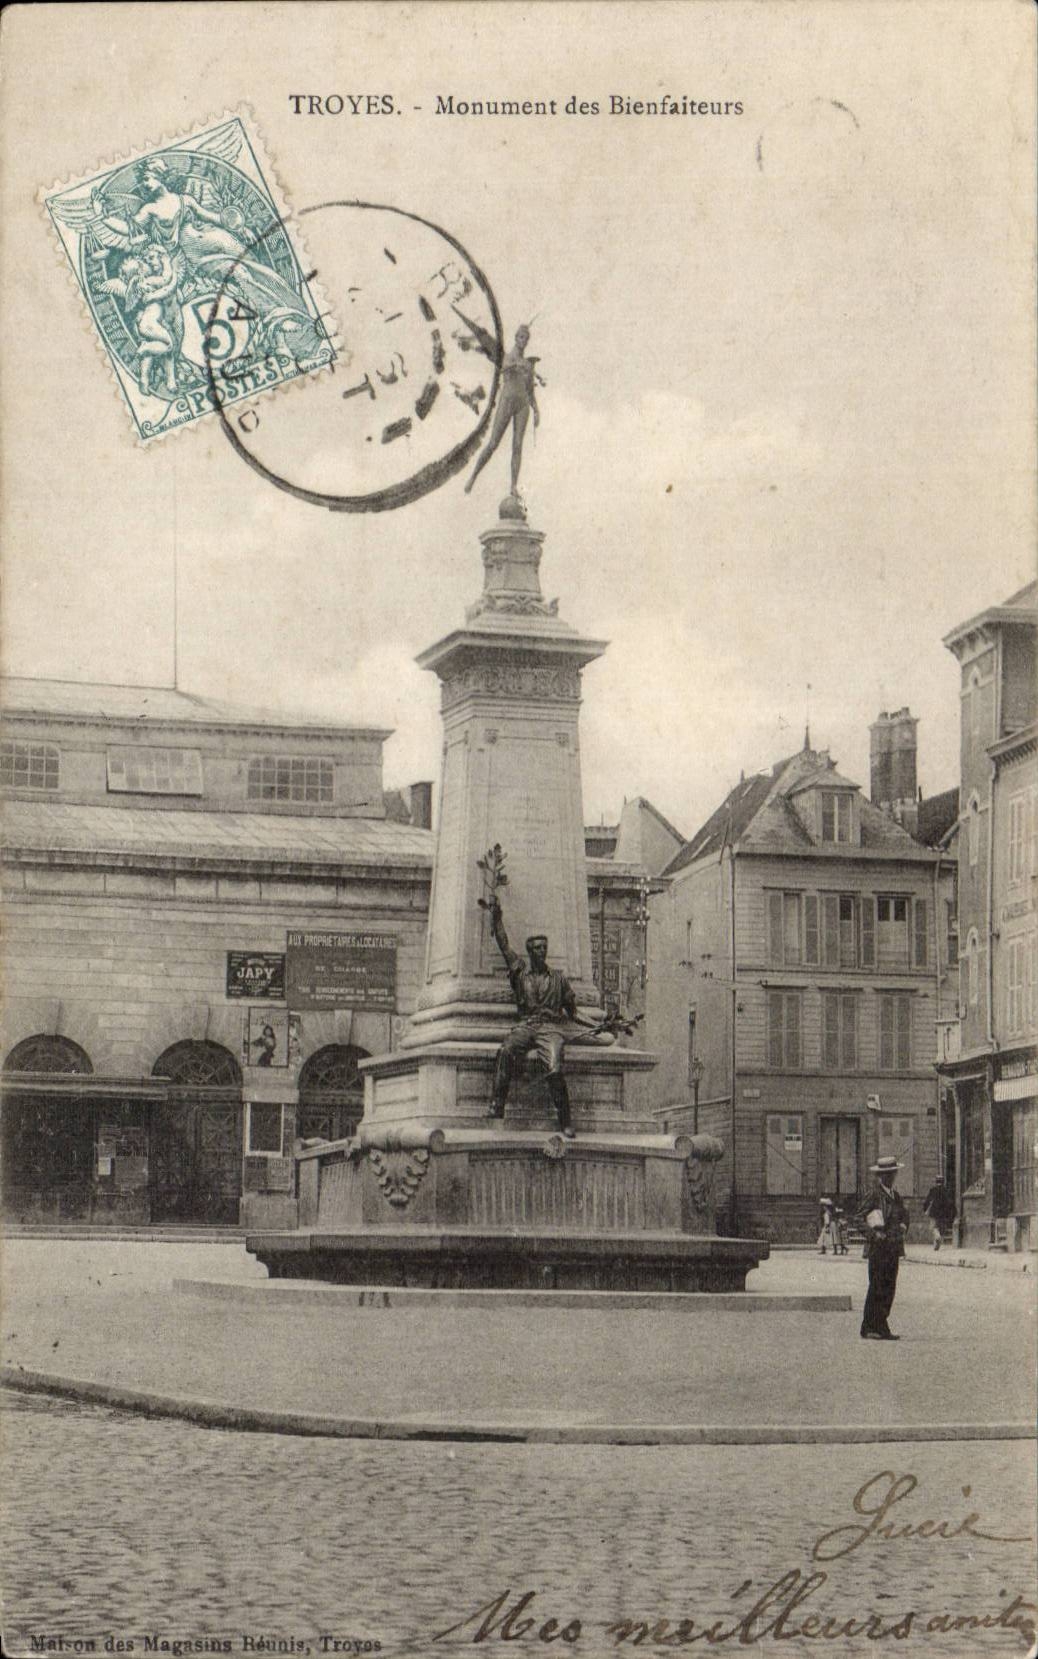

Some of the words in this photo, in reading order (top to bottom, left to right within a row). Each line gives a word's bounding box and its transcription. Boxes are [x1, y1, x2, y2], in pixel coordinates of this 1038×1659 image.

[191, 298, 237, 361] 5
[189, 361, 279, 414] POSTES
[237, 967, 274, 980] JAPY
[813, 1470, 1032, 1561] Lucie
[434, 1589, 583, 1643] Mes
[603, 1567, 913, 1647] meilleurs
